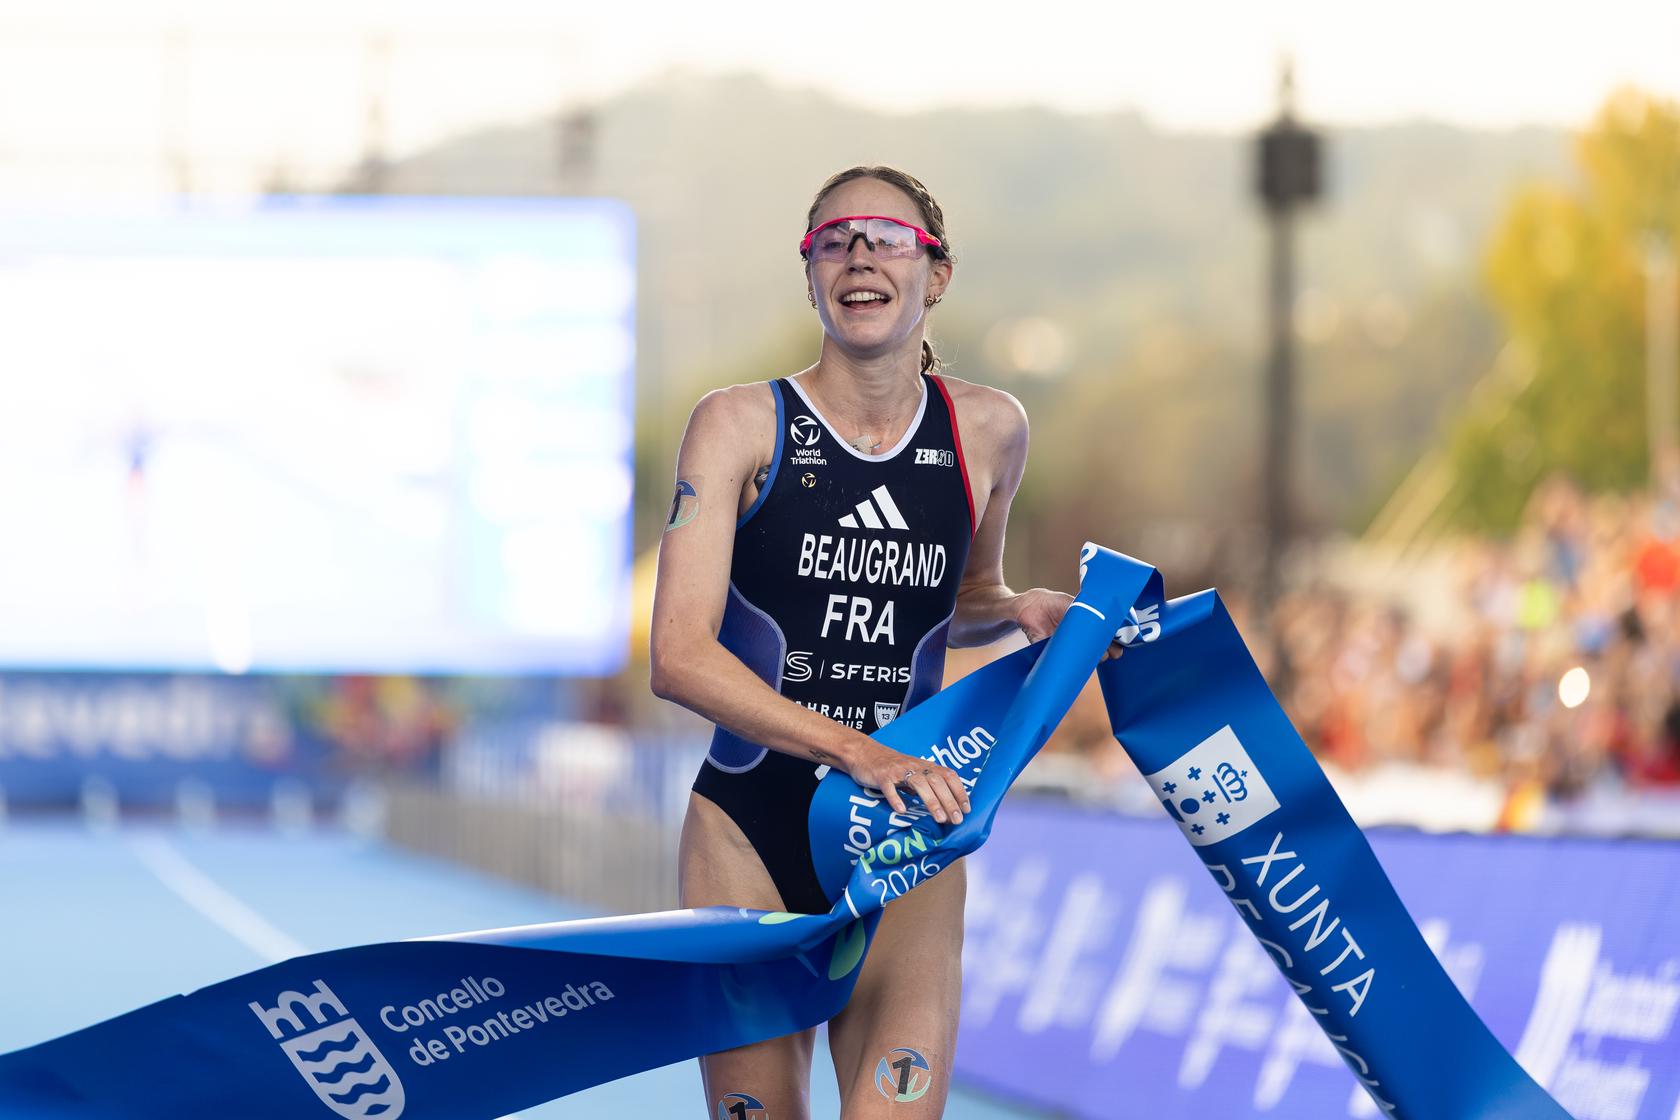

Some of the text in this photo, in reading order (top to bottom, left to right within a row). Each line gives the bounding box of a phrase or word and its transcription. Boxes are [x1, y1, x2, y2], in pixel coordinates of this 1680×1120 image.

[790, 456, 827, 466] Triathlon
[795, 448, 820, 457] World
[798, 532, 946, 588] BEAUGRAND
[820, 593, 895, 646] FRA
[795, 700, 867, 720] HRAIN
[871, 855, 940, 905] 2026
[1241, 831, 1375, 1018] XUNTA
[379, 976, 506, 1033] Concello
[409, 981, 615, 1067] de Pontevedra
[892, 1056, 913, 1095] 1
